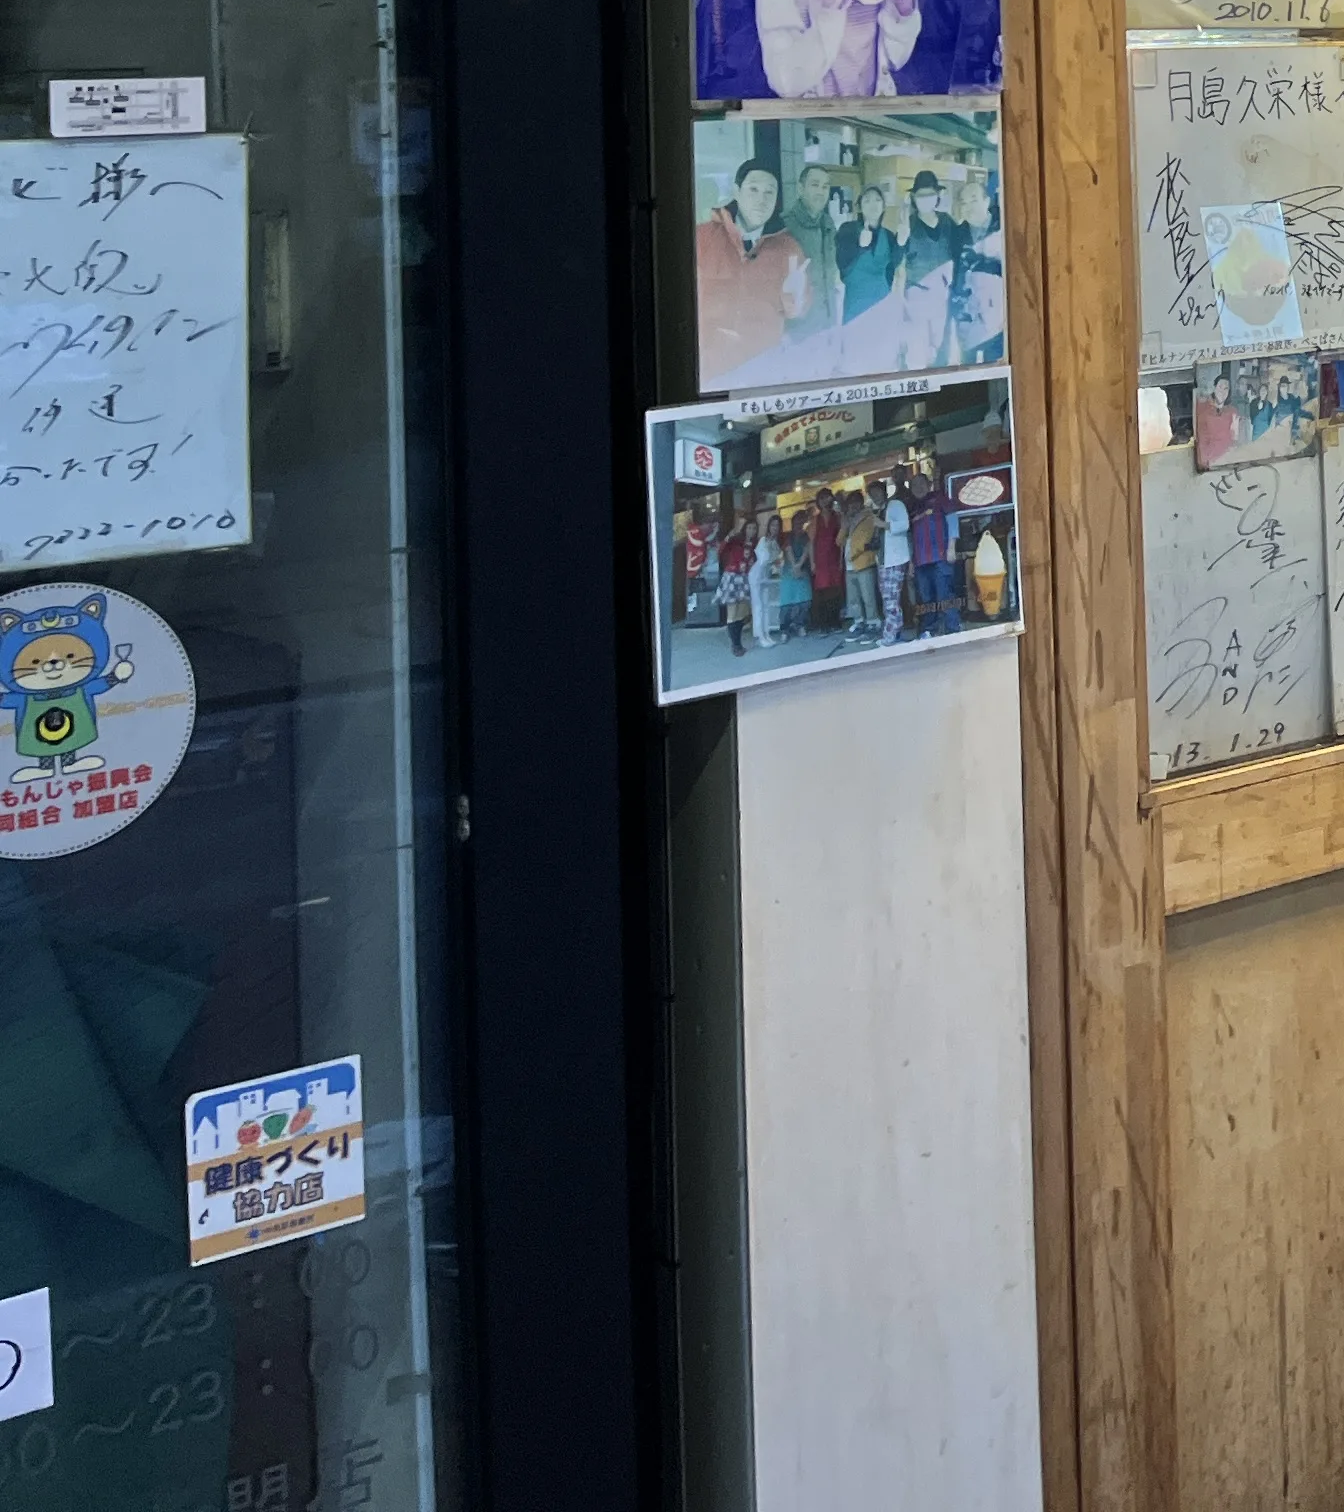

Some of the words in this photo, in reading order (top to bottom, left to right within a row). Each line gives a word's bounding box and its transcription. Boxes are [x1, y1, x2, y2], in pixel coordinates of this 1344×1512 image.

[205, 1131, 349, 1196] 健康づくり
[233, 1171, 325, 1223] 協力店
